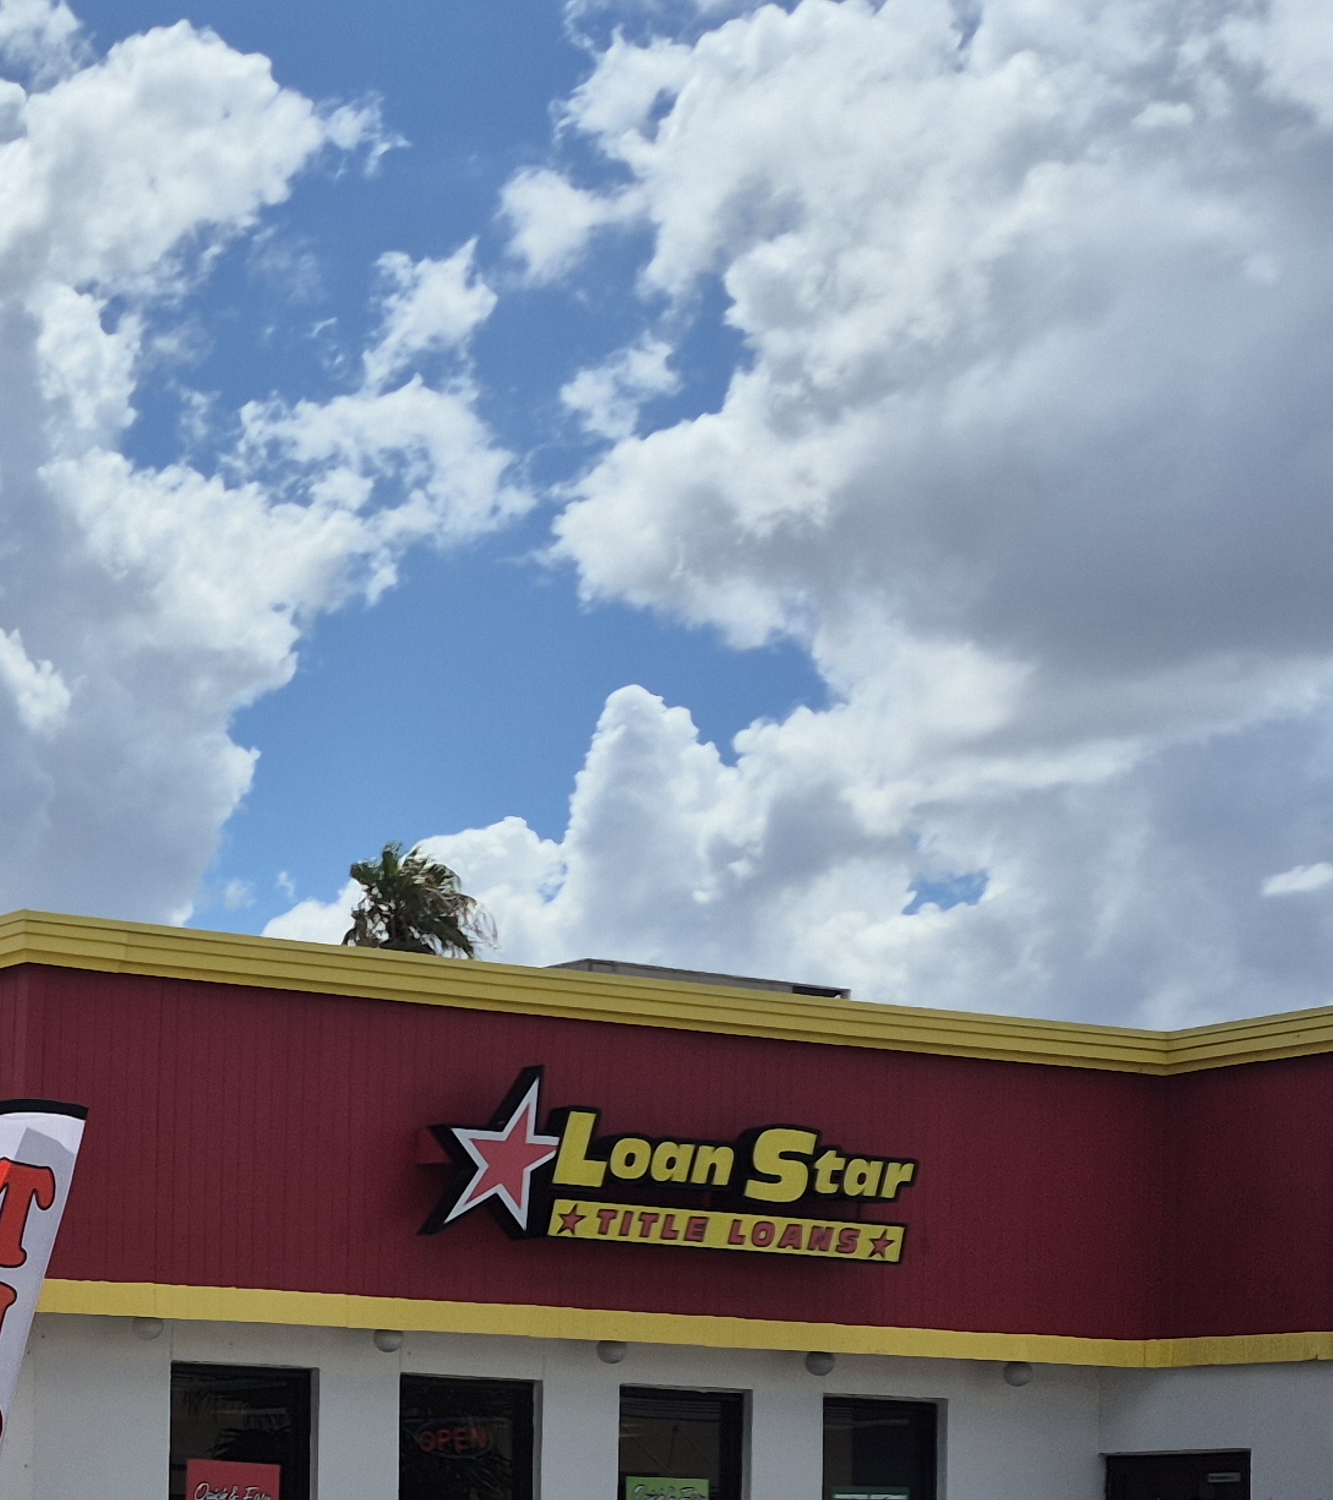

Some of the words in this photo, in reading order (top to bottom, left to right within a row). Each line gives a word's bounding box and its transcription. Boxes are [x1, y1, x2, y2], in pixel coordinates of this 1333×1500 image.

[552, 1110, 734, 1188] Loan
[744, 1127, 915, 1203] Star
[597, 1208, 709, 1243] TITLE
[729, 1219, 861, 1255] LOANS
